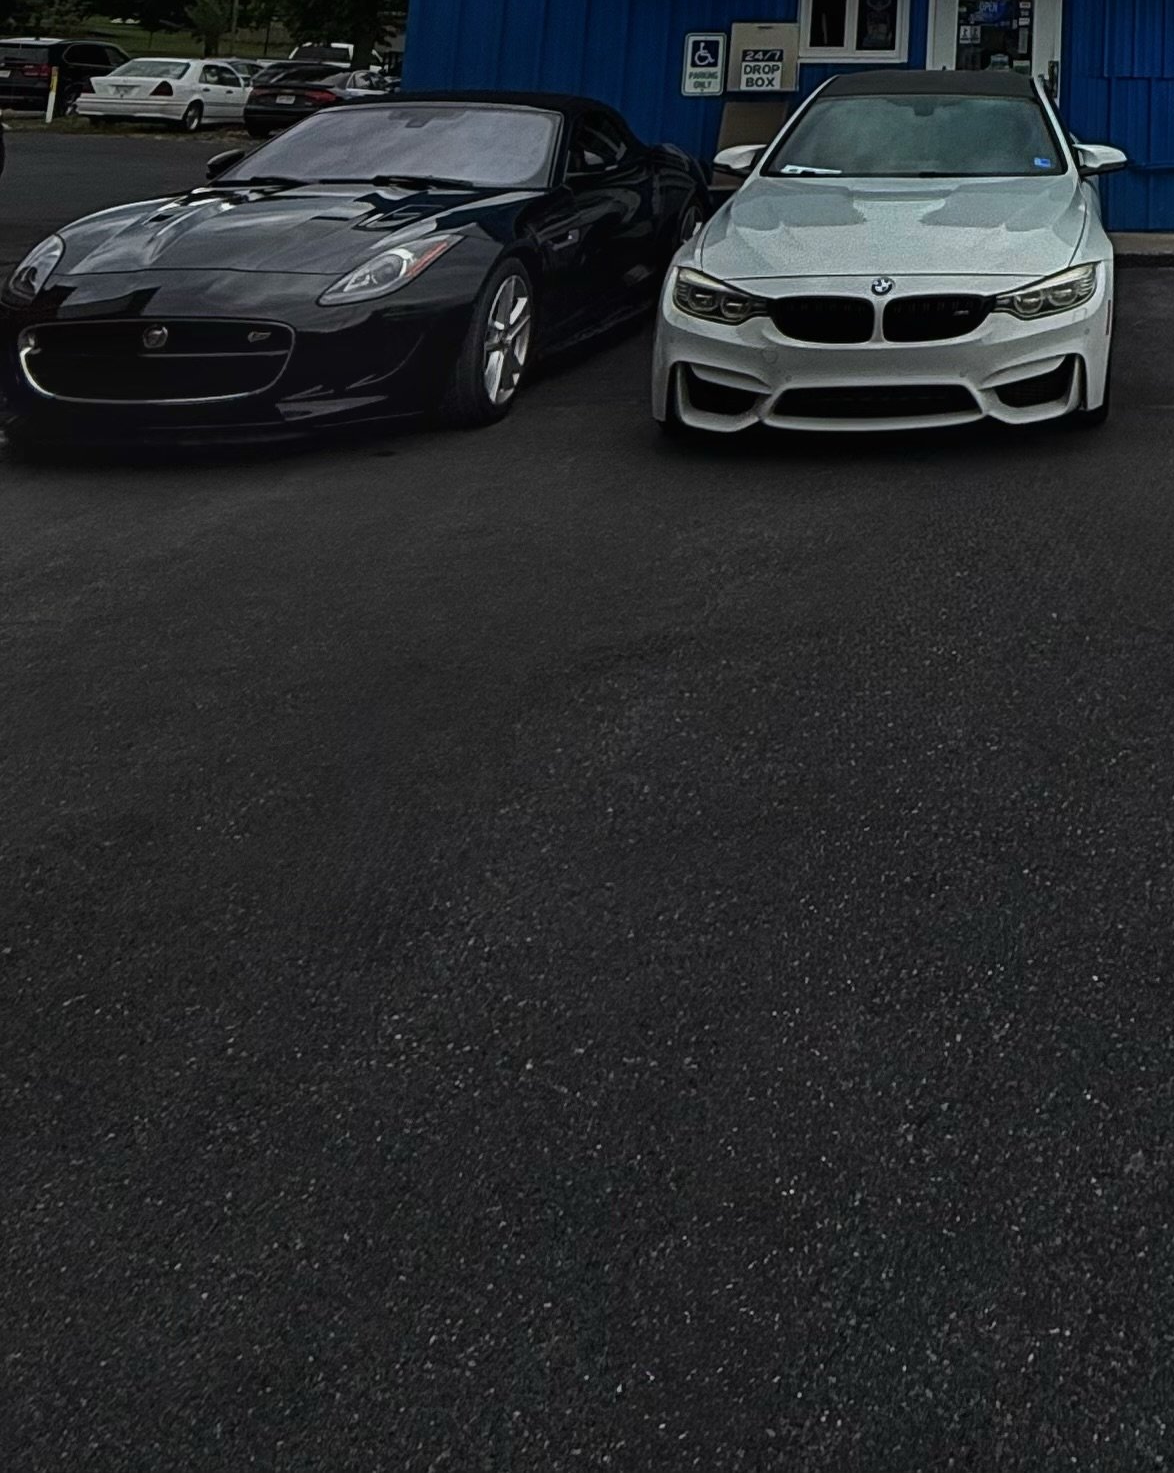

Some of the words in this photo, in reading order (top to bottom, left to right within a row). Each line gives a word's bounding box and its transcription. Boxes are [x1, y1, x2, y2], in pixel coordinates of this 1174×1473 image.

[745, 51, 780, 61] 24/7
[743, 64, 780, 75] DROP
[745, 77, 775, 87] BOX
